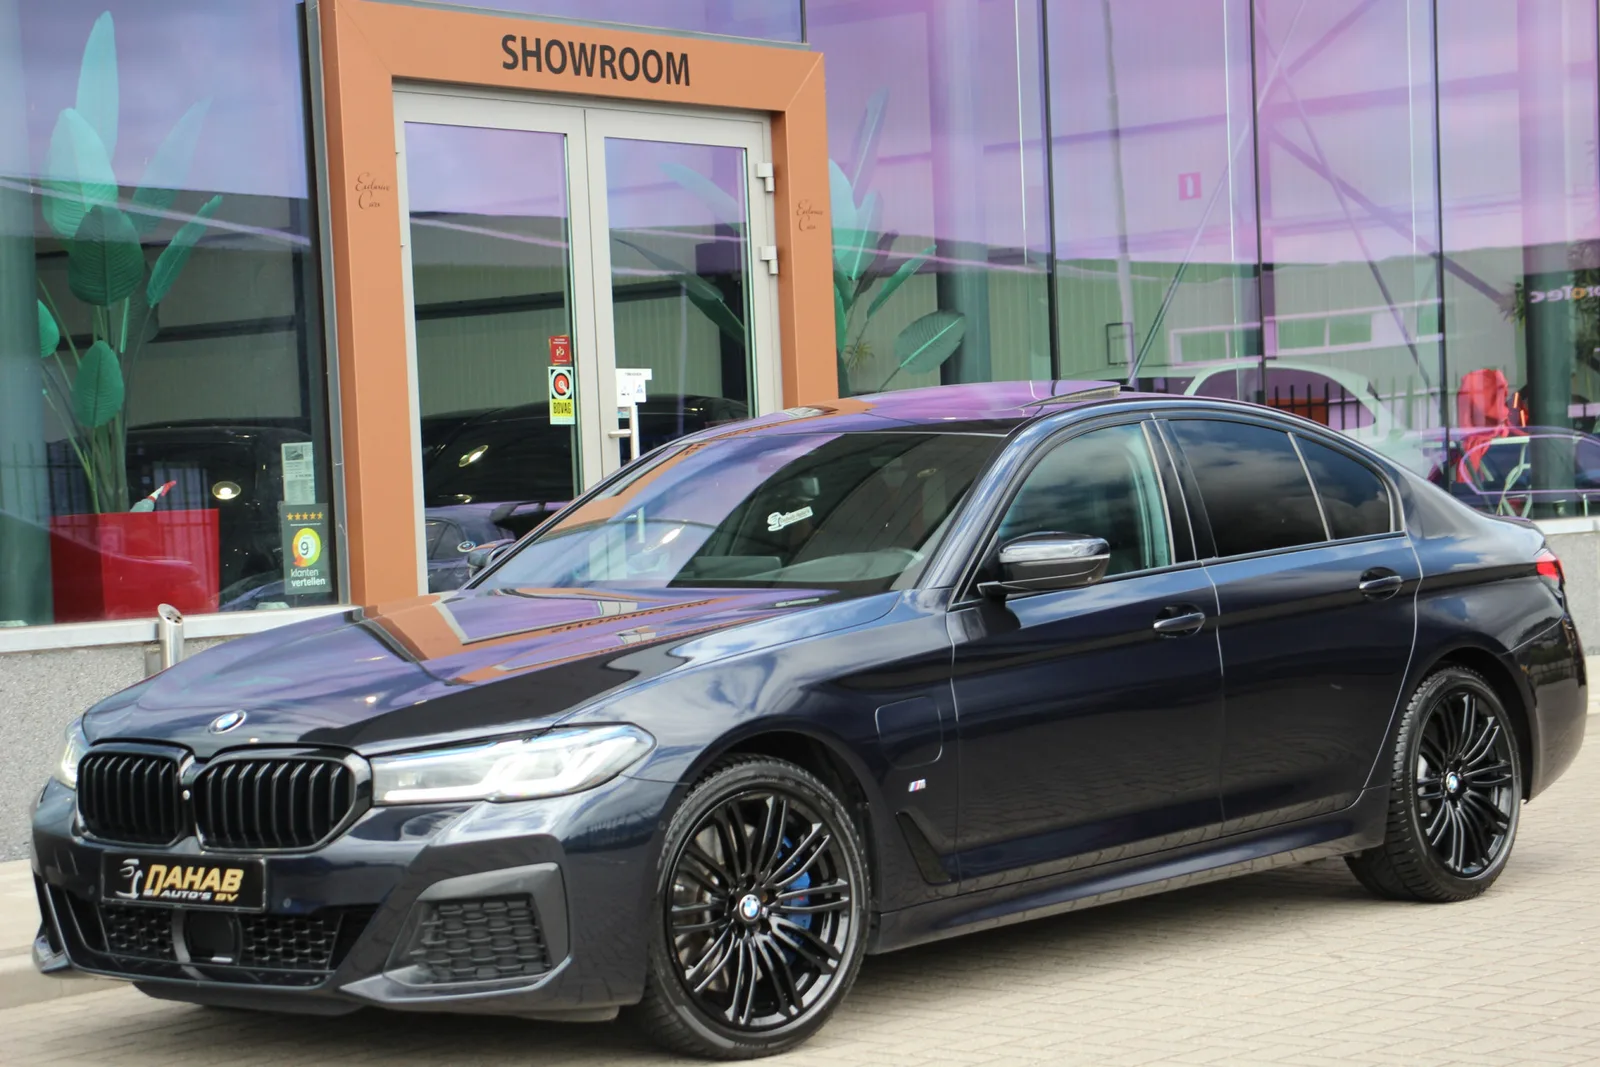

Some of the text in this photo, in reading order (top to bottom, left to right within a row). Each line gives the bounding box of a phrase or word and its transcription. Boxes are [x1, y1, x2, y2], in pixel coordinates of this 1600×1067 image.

[502, 34, 690, 86] SHOWROOM
[553, 402, 571, 415] BOVAG
[300, 541, 309, 556] 9
[290, 568, 319, 578] klanten
[291, 577, 326, 587] vertellen
[160, 889, 239, 902] AUTO'S BV
